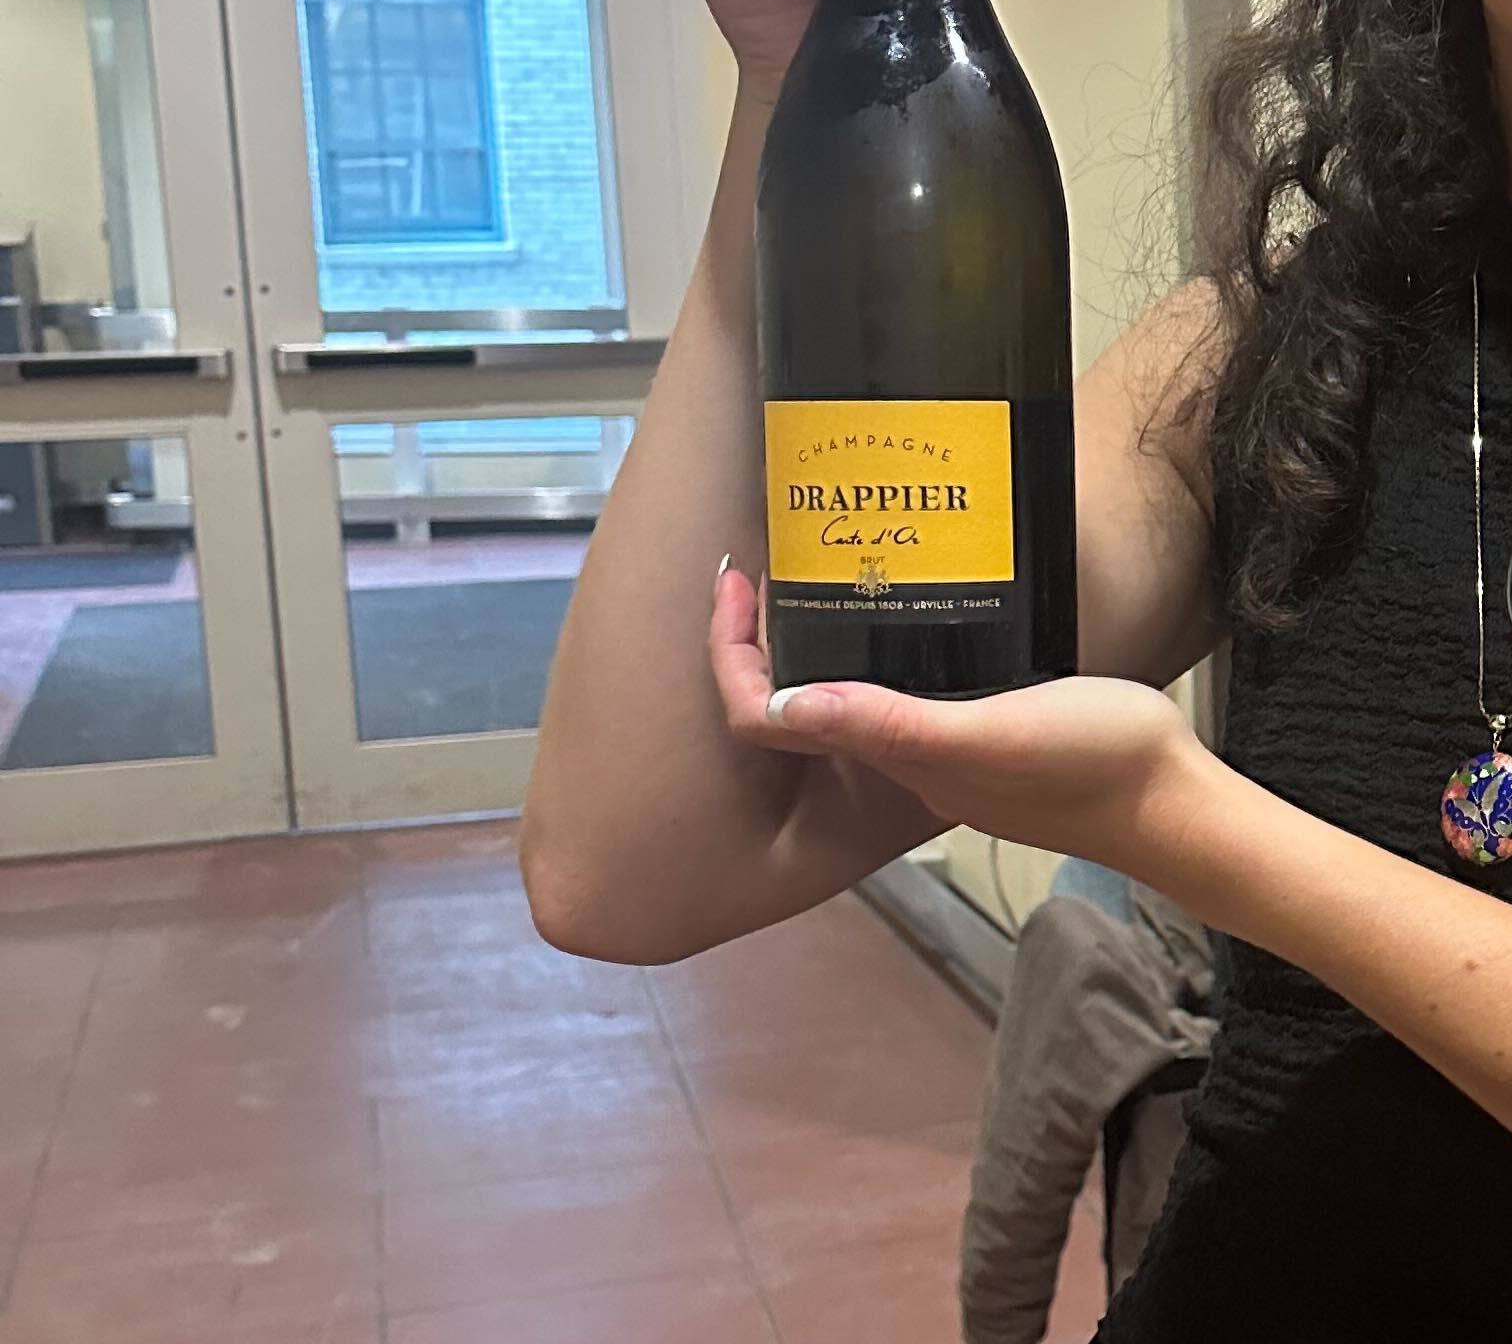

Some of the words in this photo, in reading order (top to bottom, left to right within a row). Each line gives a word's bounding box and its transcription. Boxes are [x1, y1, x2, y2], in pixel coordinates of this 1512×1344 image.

[798, 434, 953, 463] CHAMPAGNE
[788, 484, 970, 511] DRAPPIER
[821, 515, 864, 546] Carte
[871, 526, 920, 545] d'Or
[860, 556, 886, 565] BRUT
[913, 600, 953, 610] URVILLE
[963, 598, 1000, 608] FRANCE
